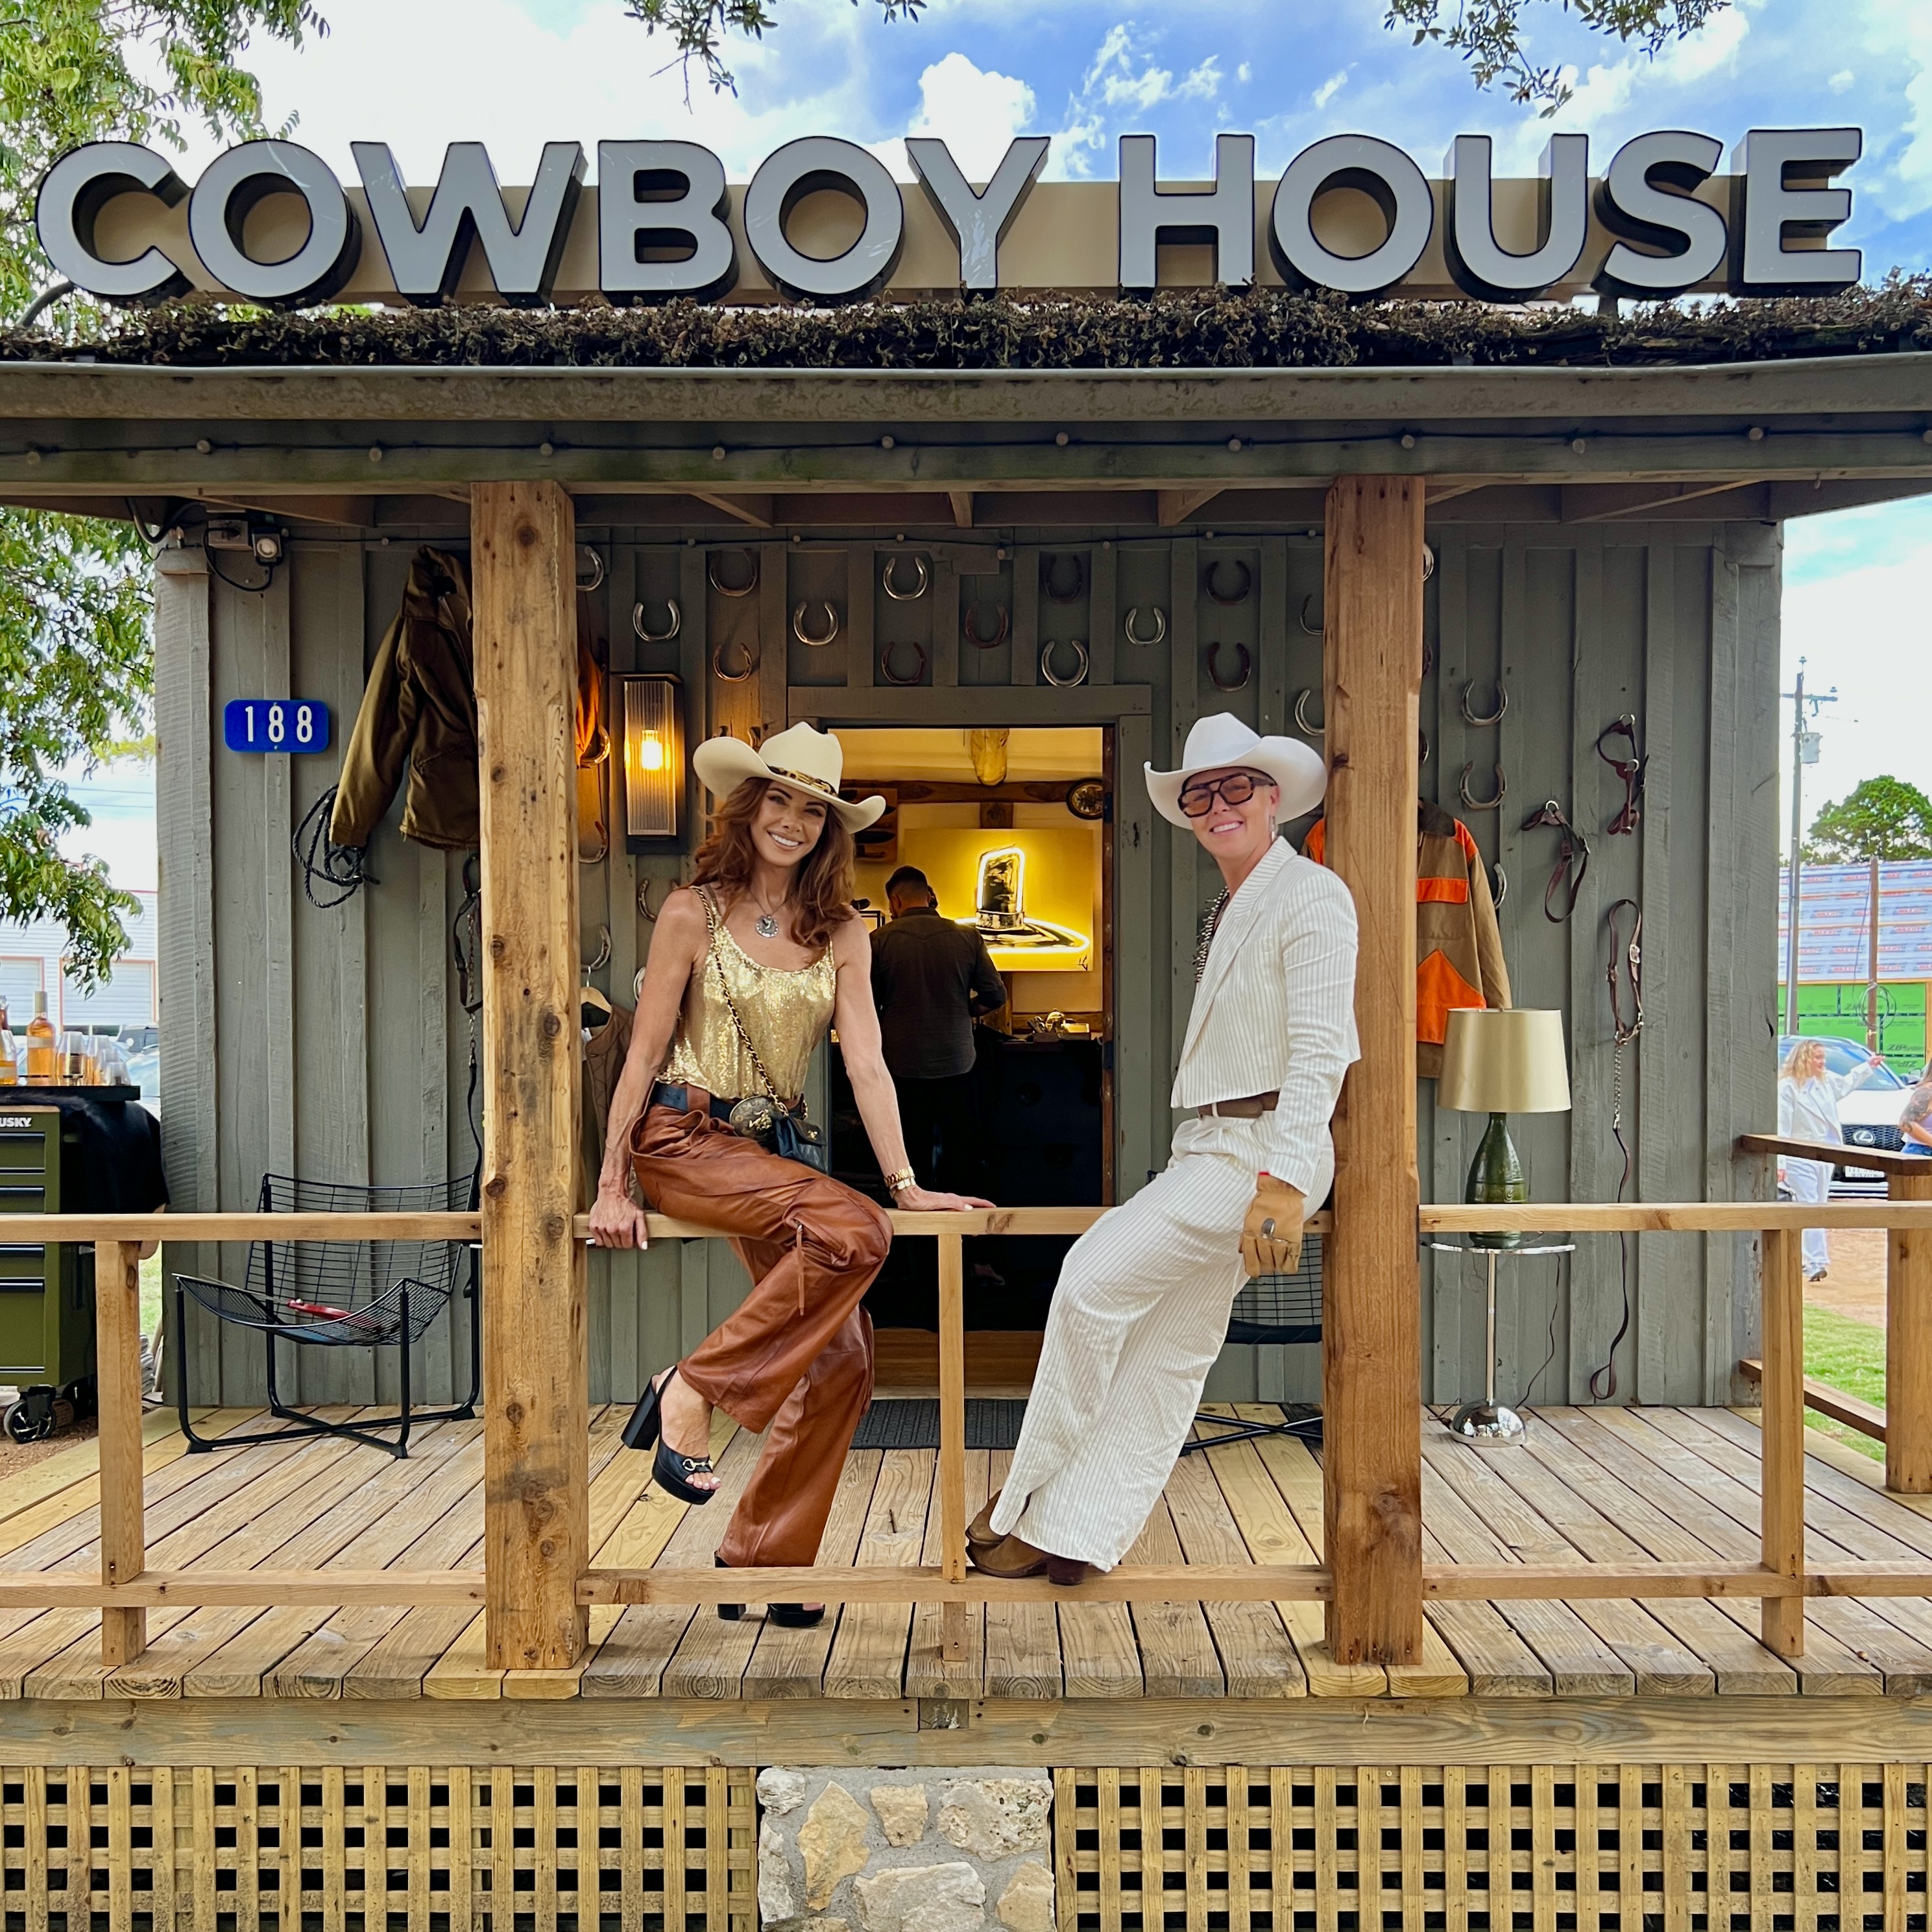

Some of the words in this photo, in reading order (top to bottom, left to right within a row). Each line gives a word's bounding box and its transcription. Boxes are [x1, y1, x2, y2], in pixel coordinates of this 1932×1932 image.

[35, 136, 1050, 300] COWBOY
[1118, 128, 1862, 292] HOUSE
[245, 705, 313, 743] 188
